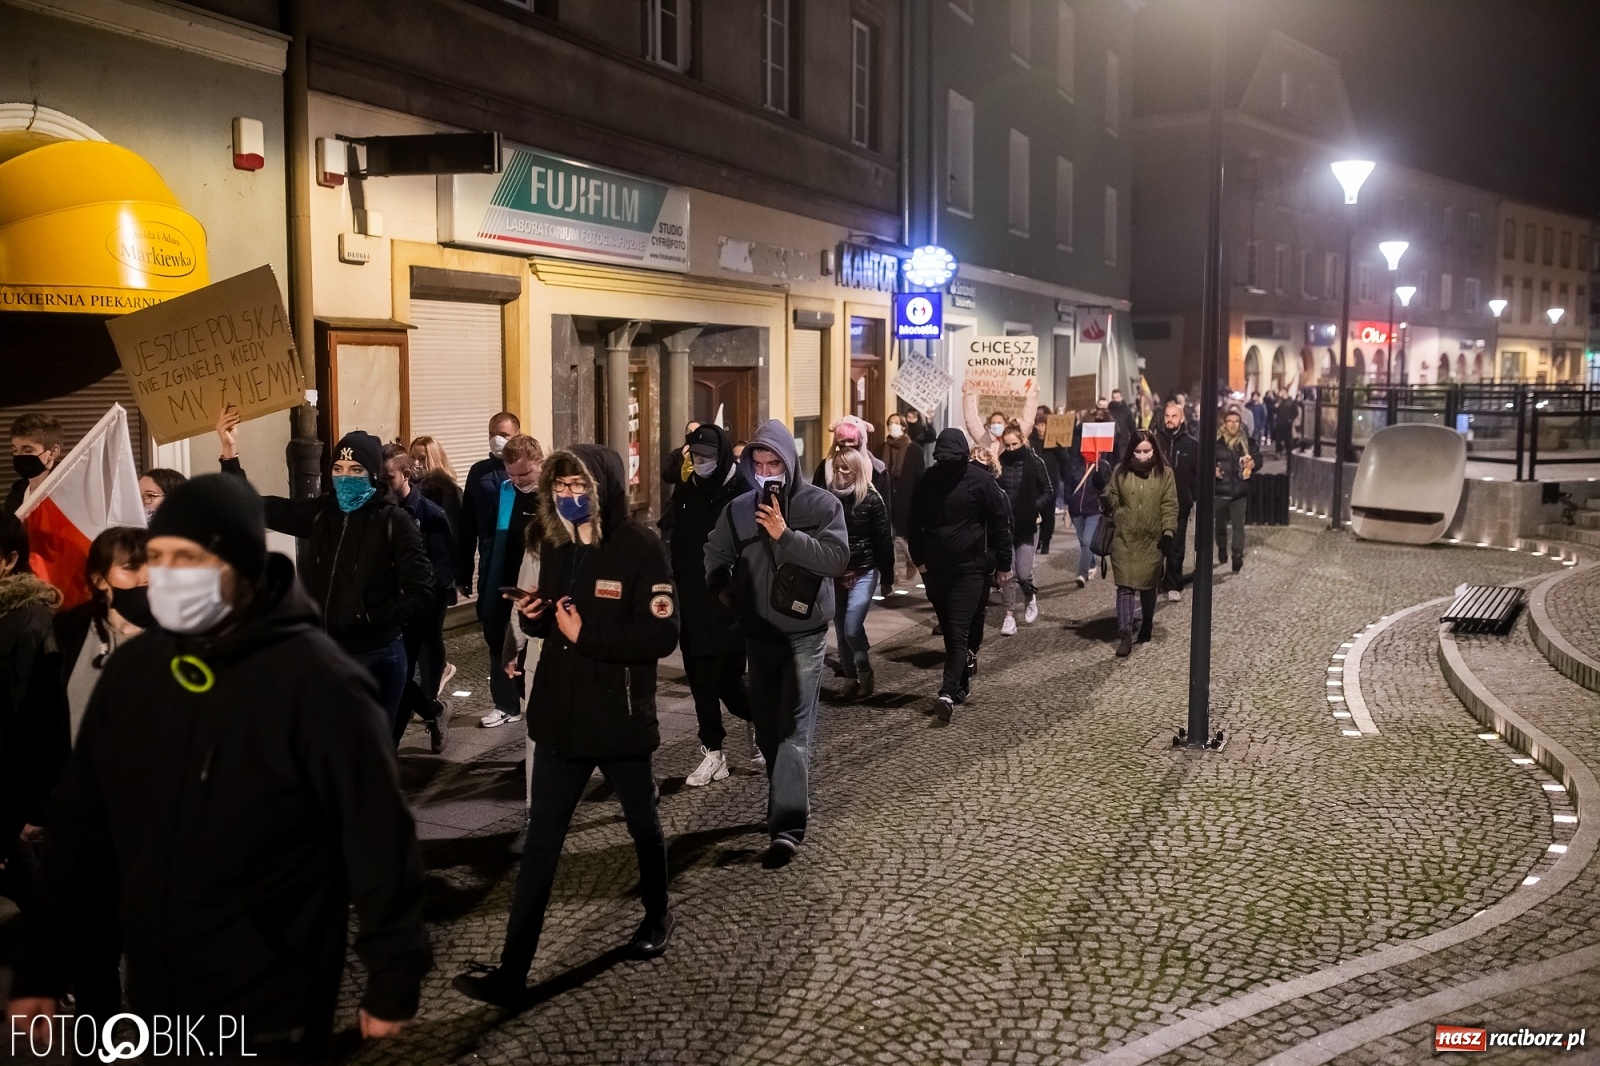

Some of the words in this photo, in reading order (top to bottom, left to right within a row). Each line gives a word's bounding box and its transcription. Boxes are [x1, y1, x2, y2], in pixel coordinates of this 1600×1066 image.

[531, 165, 639, 223] FUJIFILM
[506, 217, 580, 242] LABORATORIUM
[581, 231, 646, 252] FOTOGRAFICZNE
[658, 222, 683, 237] STUDIO
[162, 232, 181, 246] Adam
[651, 236, 686, 251] CYFR@FOTO
[120, 243, 192, 267] Markiewka
[842, 246, 898, 292] KANTOR
[898, 324, 940, 336] Monetia
[132, 325, 207, 377] JESZCZE
[206, 304, 285, 348] POLSKA
[970, 341, 1034, 354] CHCESZ
[138, 376, 161, 396] NIE
[161, 353, 225, 389] ZGINEŁA
[229, 340, 266, 367] KIEDY
[967, 354, 1015, 367] CHRONIĆ
[1019, 357, 1035, 367] ???
[965, 368, 1007, 380] FINANSUJ
[168, 386, 209, 424] MY
[340, 447, 354, 461] NY
